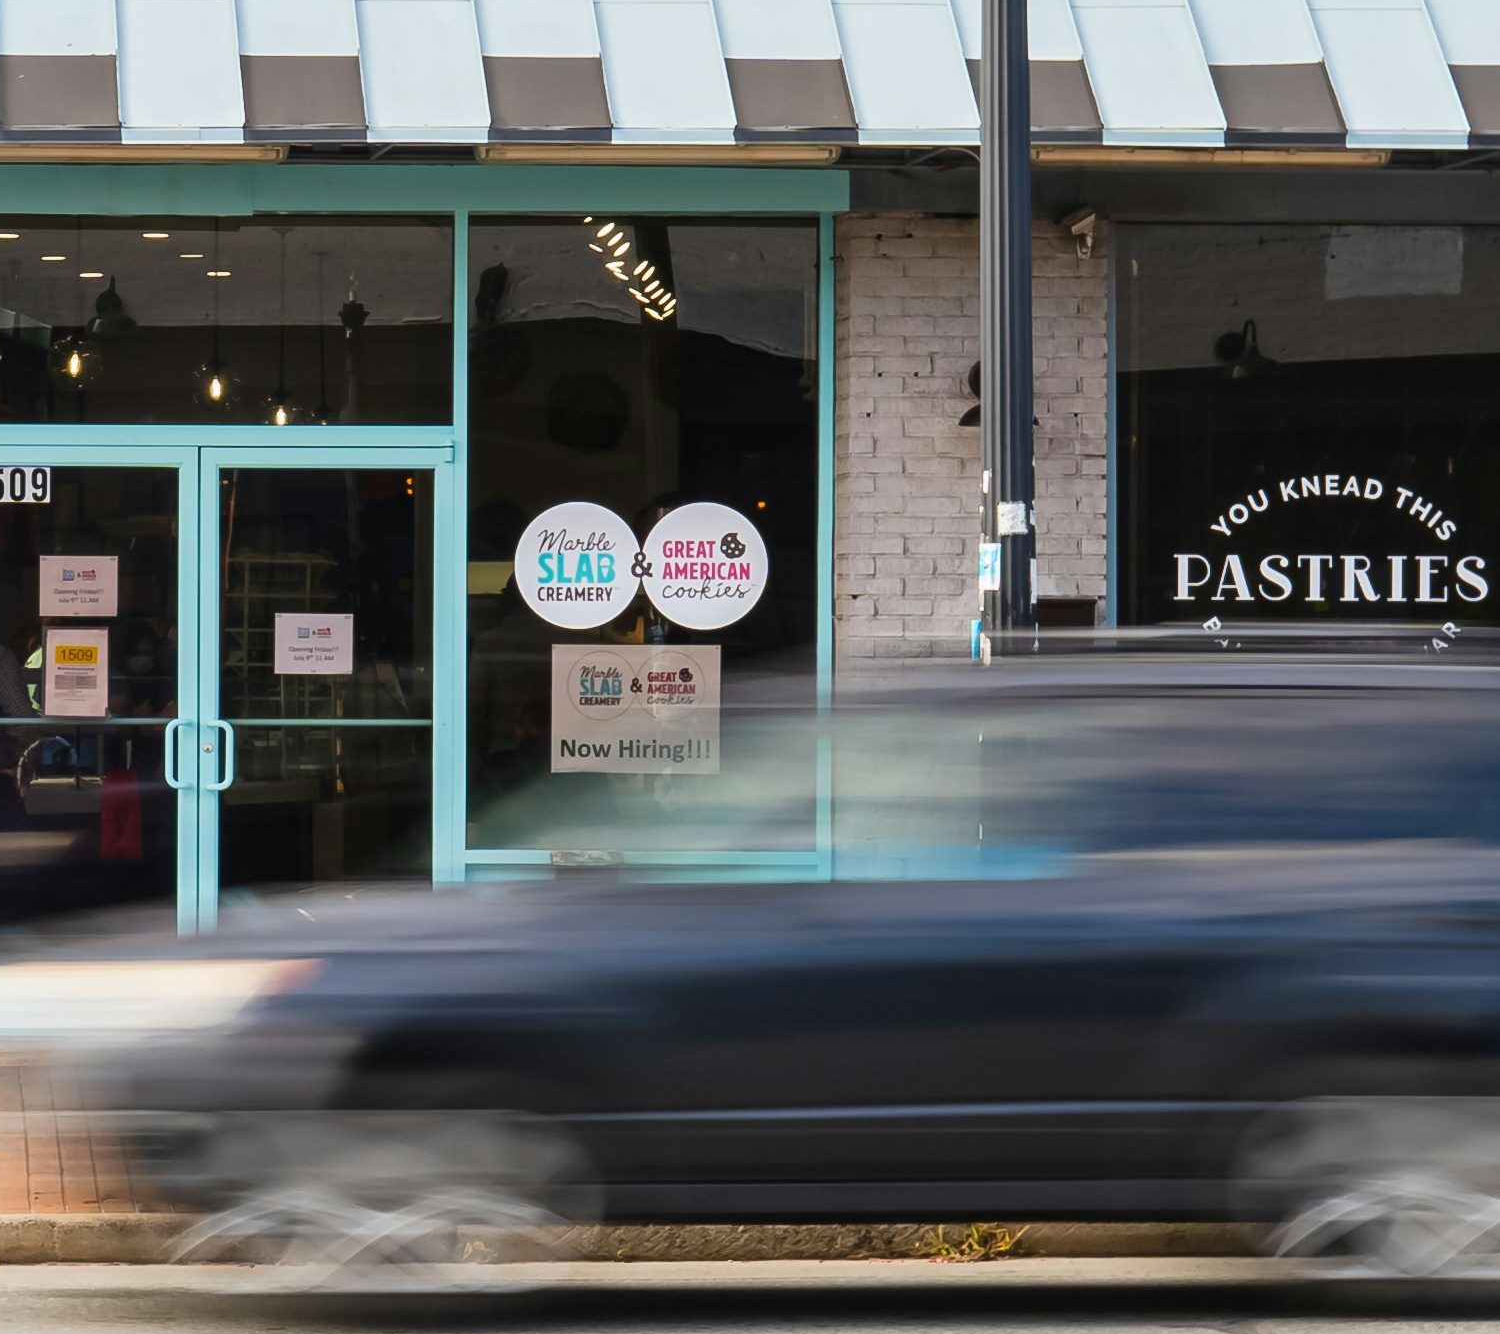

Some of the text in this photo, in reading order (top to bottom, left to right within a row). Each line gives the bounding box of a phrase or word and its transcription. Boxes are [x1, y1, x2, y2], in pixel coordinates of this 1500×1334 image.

[1210, 474, 1458, 541] YOU KNEAD THIS
[537, 528, 616, 555] Marble
[662, 540, 716, 558] GREAT
[537, 553, 616, 583] SLAB
[631, 551, 653, 578] &
[662, 562, 751, 580] AMERICAN
[1173, 554, 1489, 603] PASTRIES
[537, 587, 613, 602] CREAMERY
[662, 577, 752, 600] cookies
[60, 648, 94, 662] 1509
[579, 666, 622, 679] Marble
[647, 671, 677, 683] GREAT
[579, 678, 622, 696] SLAB
[630, 677, 643, 693] &
[646, 684, 696, 695] AMERICAN
[579, 697, 621, 706] CREAMERY
[560, 739, 711, 763] Now Hiring!!!
